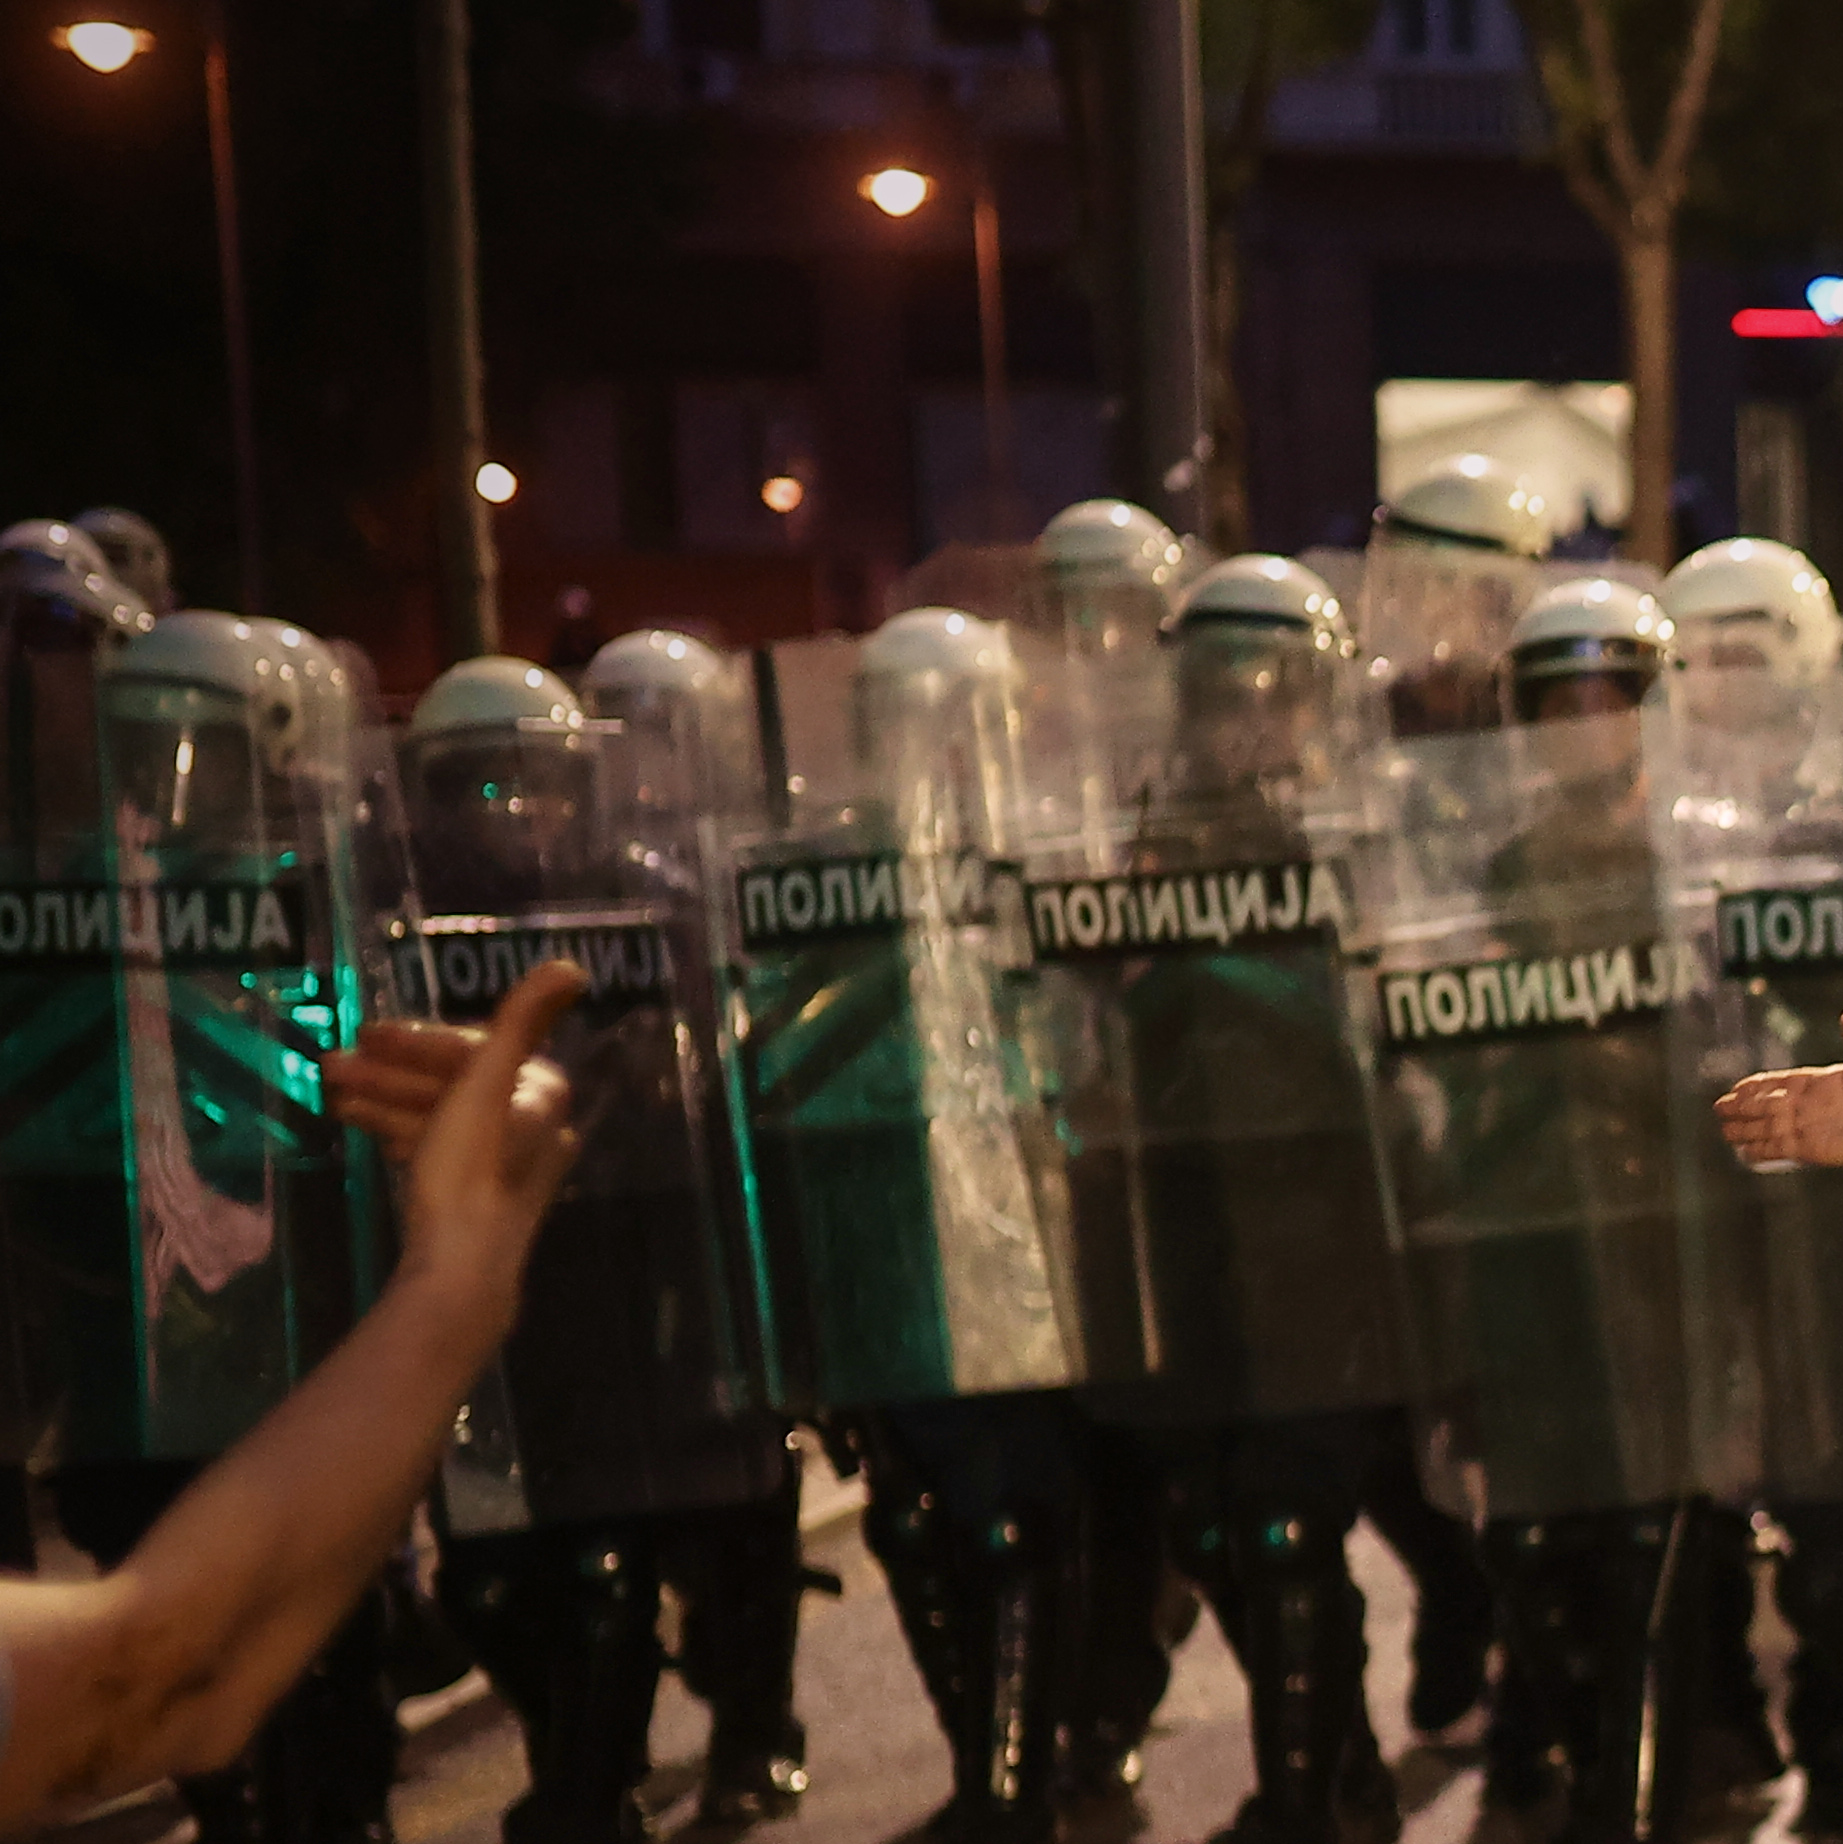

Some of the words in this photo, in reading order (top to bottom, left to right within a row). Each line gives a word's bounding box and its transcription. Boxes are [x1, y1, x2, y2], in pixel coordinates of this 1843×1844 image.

[0, 888, 292, 964] ОЛИЦИЈА
[1033, 863, 1346, 948] ПОЛИЦИЈА
[1385, 944, 1715, 1041] ПОЛИЦИЈА
